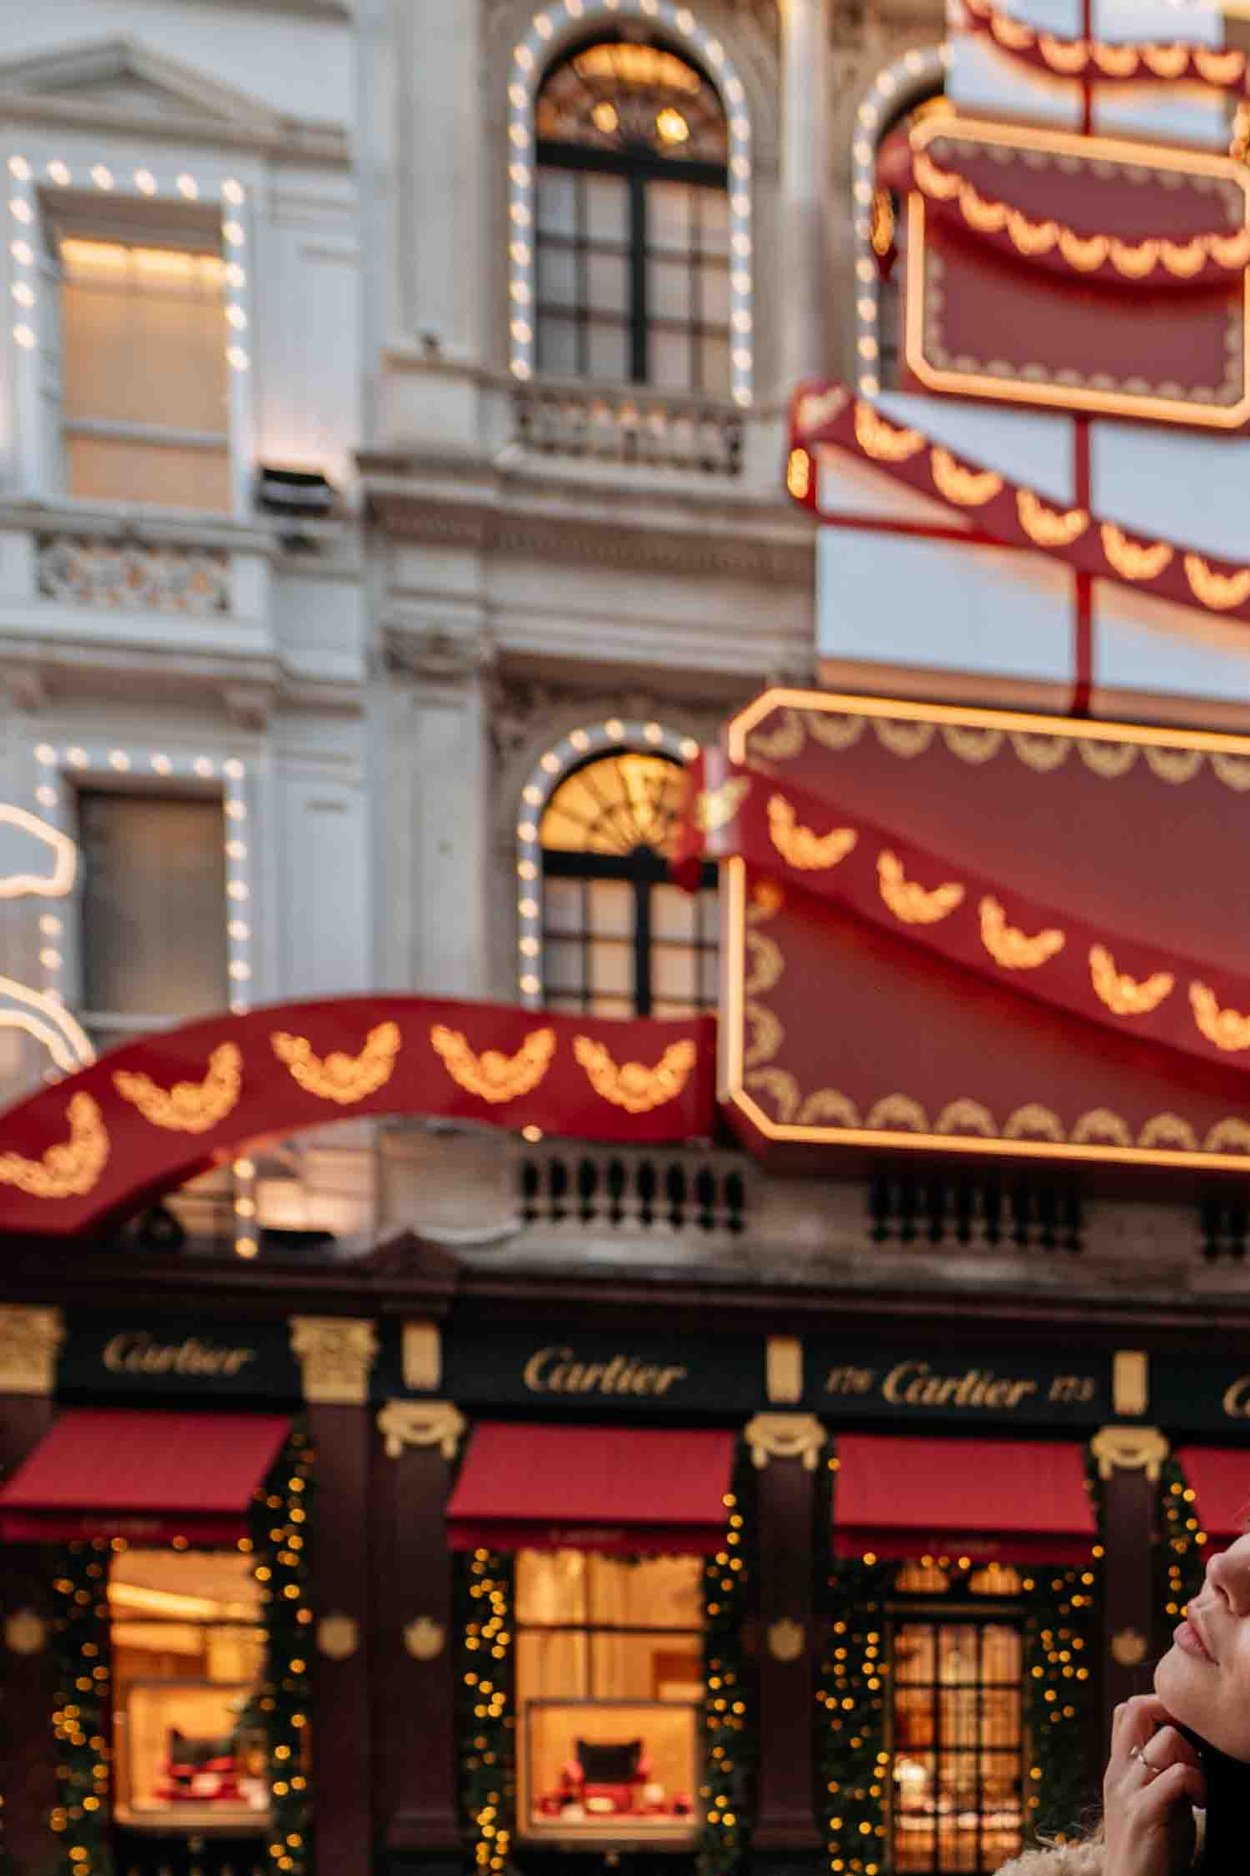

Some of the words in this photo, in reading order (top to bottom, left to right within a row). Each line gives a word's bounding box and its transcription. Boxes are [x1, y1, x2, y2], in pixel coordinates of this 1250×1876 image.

[102, 1332, 256, 1375] Cartier
[522, 1347, 686, 1396] Cartier
[882, 1360, 1037, 1407] Cartier
